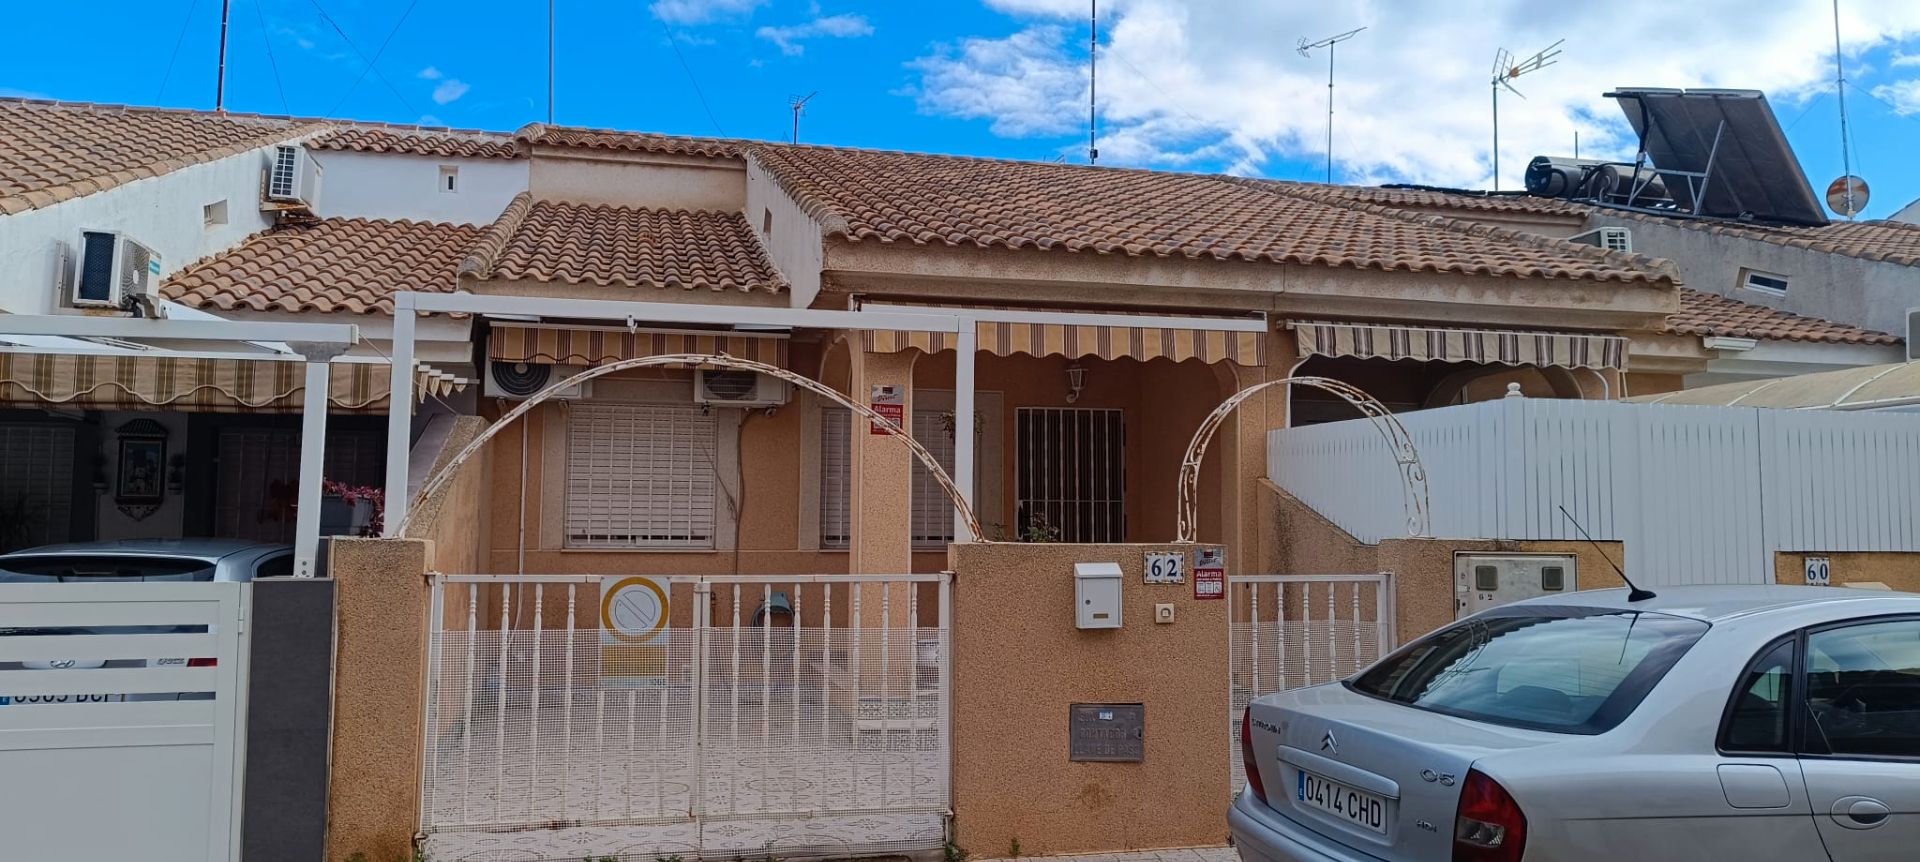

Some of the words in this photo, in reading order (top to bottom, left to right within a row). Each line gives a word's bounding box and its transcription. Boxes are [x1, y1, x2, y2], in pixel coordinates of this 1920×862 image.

[874, 405, 901, 414] Alarma
[1151, 558, 1178, 577] 62
[1196, 570, 1222, 578] Alarma
[1807, 563, 1829, 580] 60
[1305, 775, 1344, 814] 0414
[1348, 791, 1381, 829] CHD
